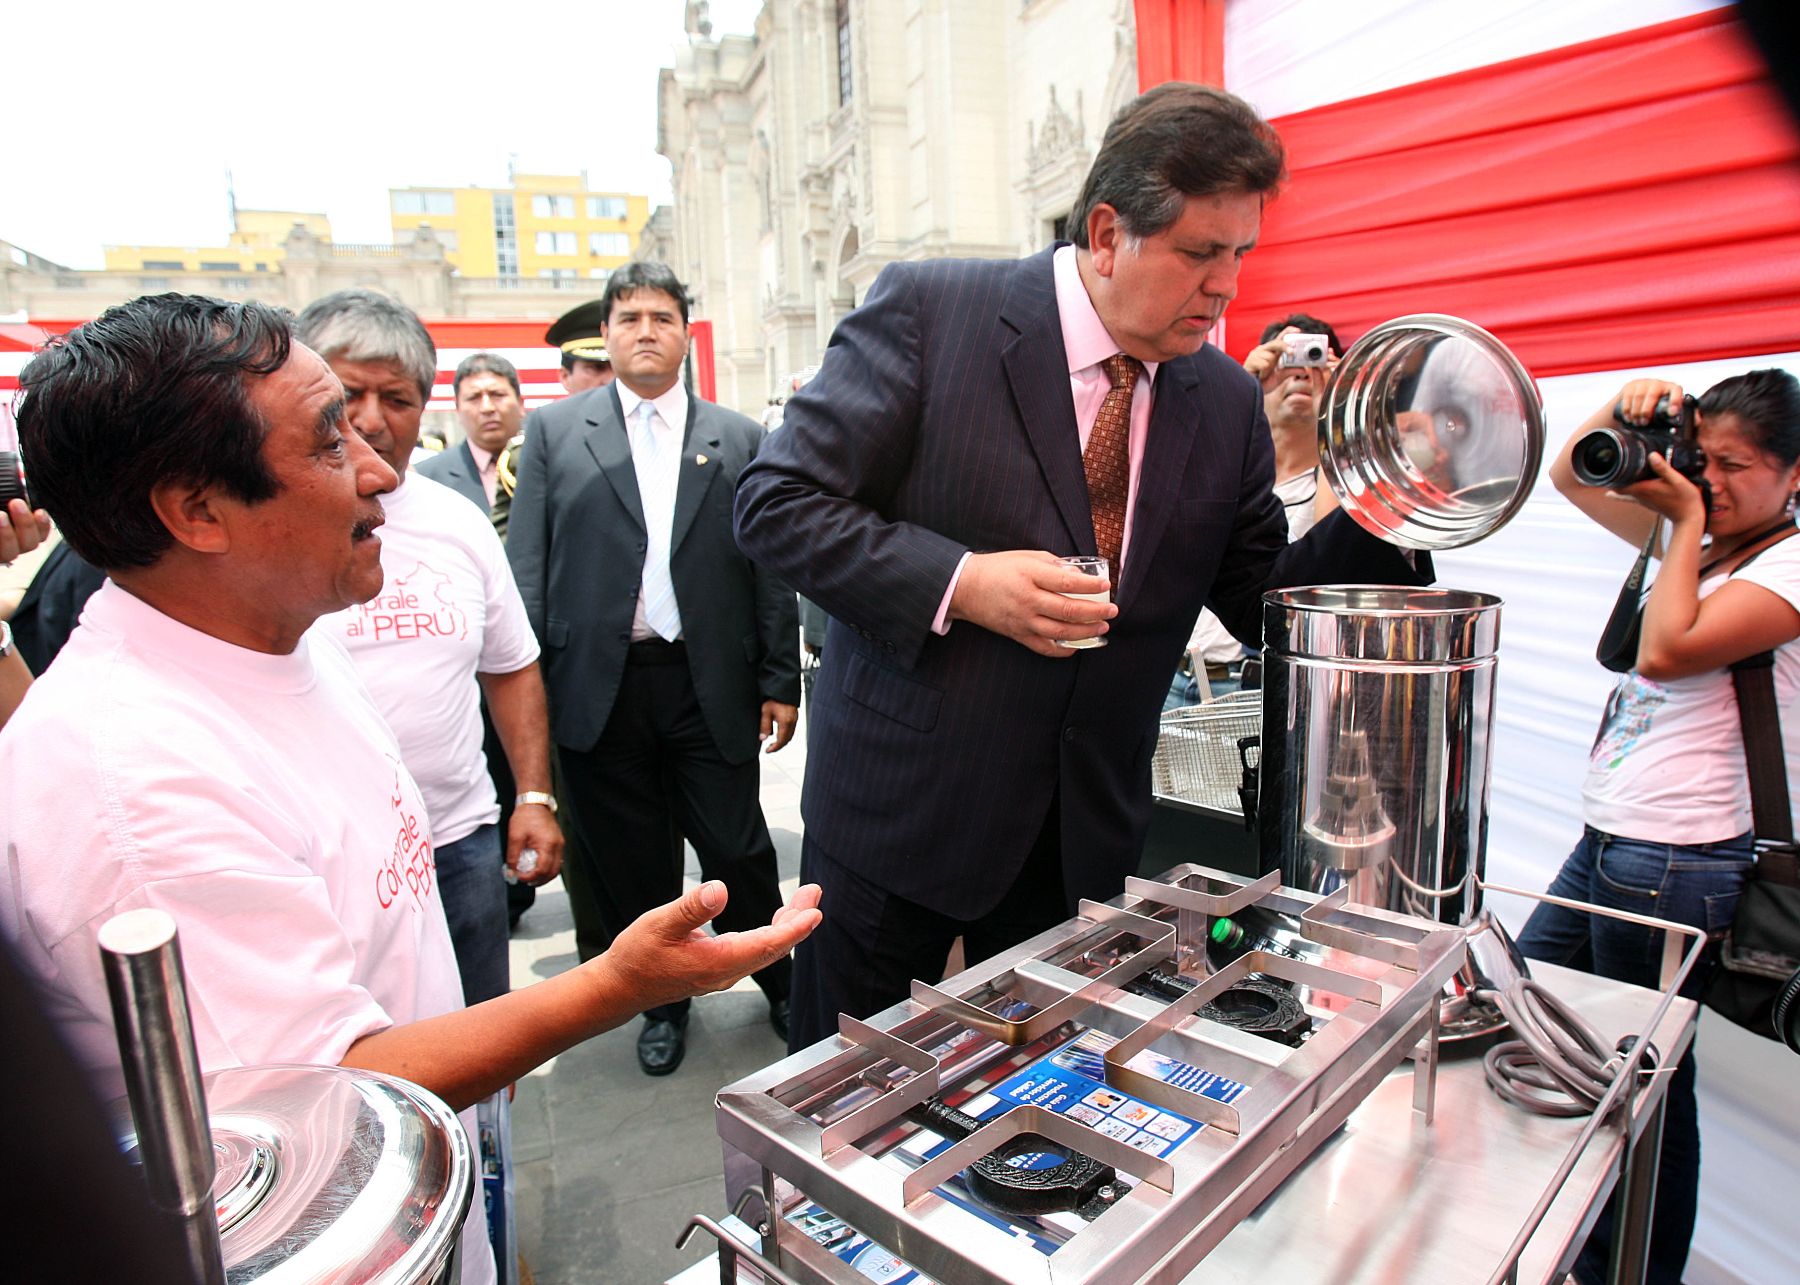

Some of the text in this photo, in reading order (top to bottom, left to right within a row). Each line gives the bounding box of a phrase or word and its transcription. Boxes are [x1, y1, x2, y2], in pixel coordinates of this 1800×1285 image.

[346, 607, 456, 640] al PERÚ
[1009, 1080, 1035, 1097] Calidad
